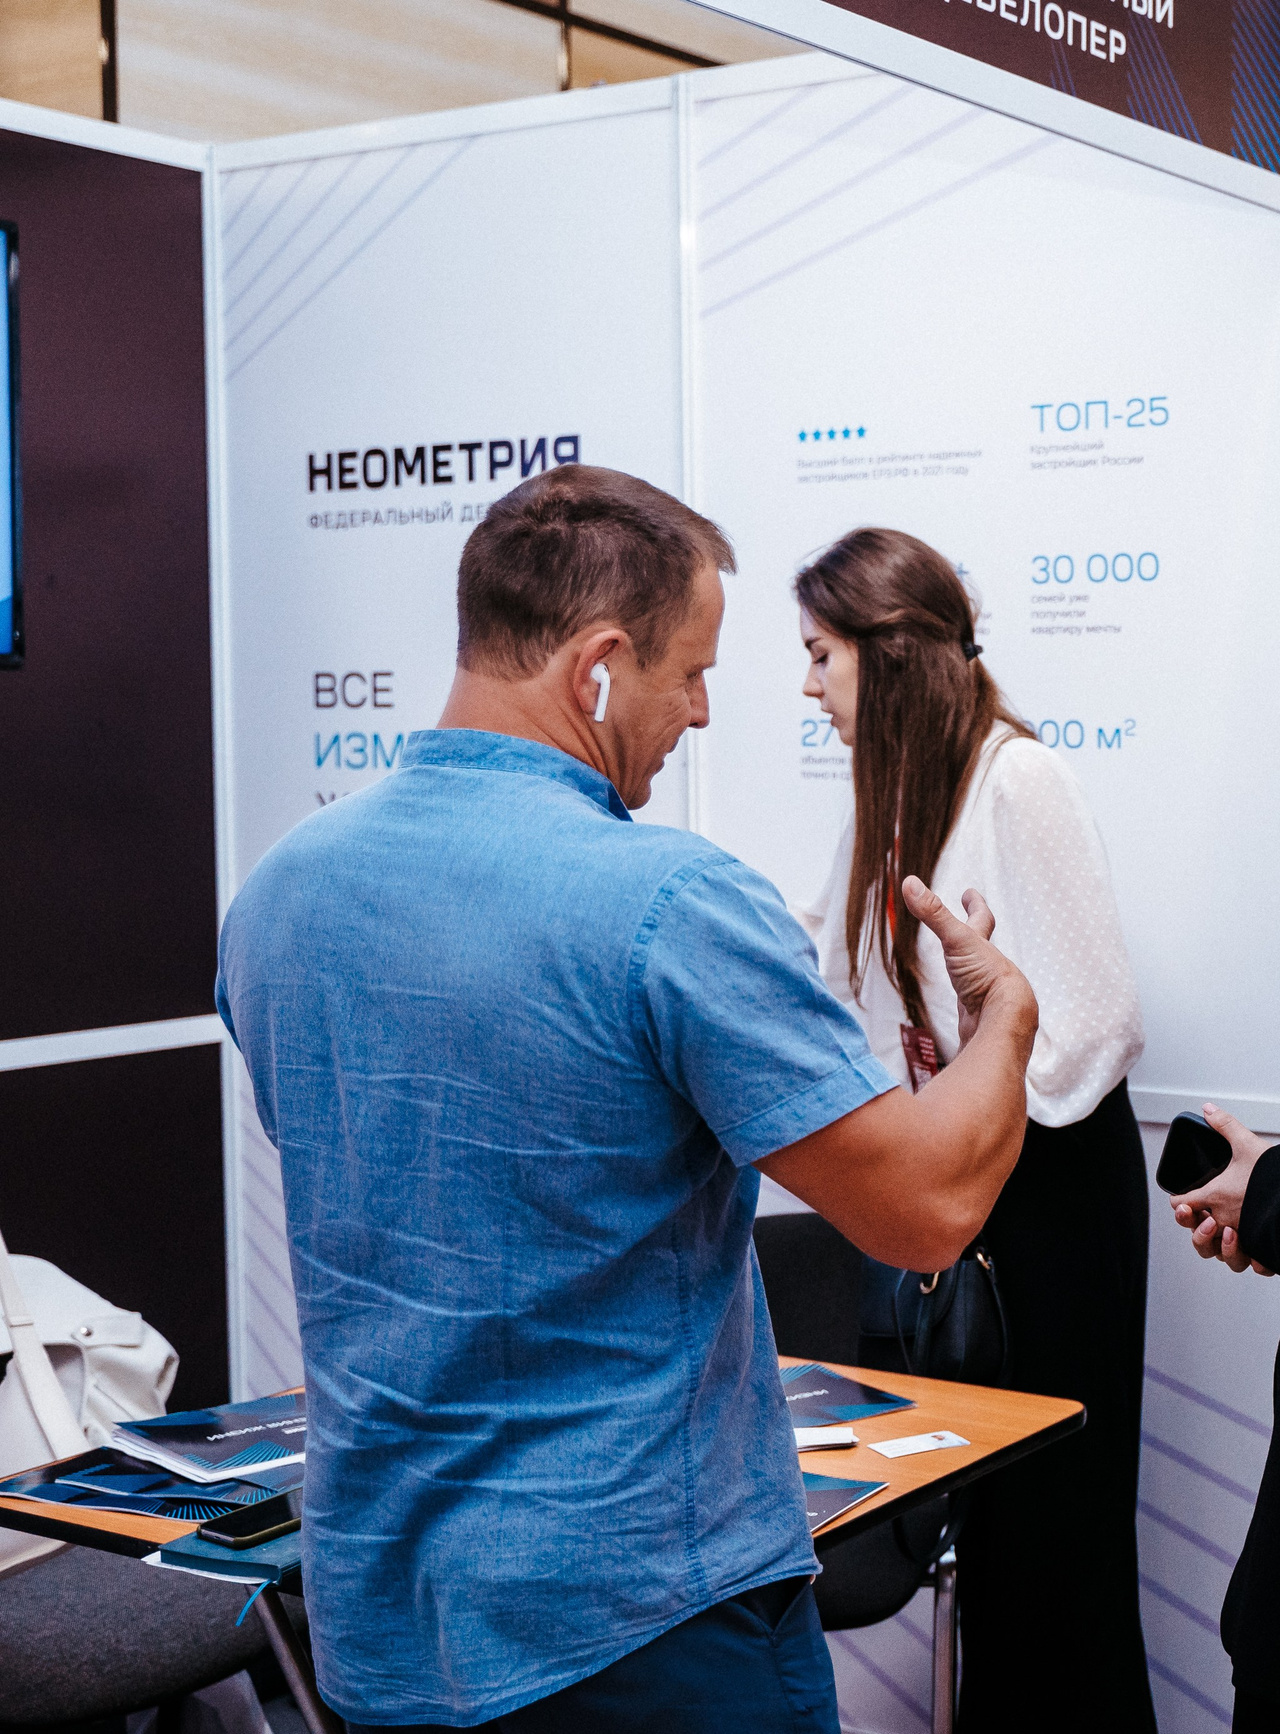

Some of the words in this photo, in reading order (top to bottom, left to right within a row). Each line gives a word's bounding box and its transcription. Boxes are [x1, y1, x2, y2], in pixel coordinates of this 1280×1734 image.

[1030, 396, 1170, 432] ТОП-25
[307, 435, 580, 492] НЕОМЕТРИЯ
[308, 501, 454, 530] ФЕДЕРАЛЬНЫЙ
[1031, 555, 1075, 584] 30
[1087, 552, 1160, 583] 000
[314, 671, 395, 709] ВСЕ
[1023, 719, 1085, 749] 00
